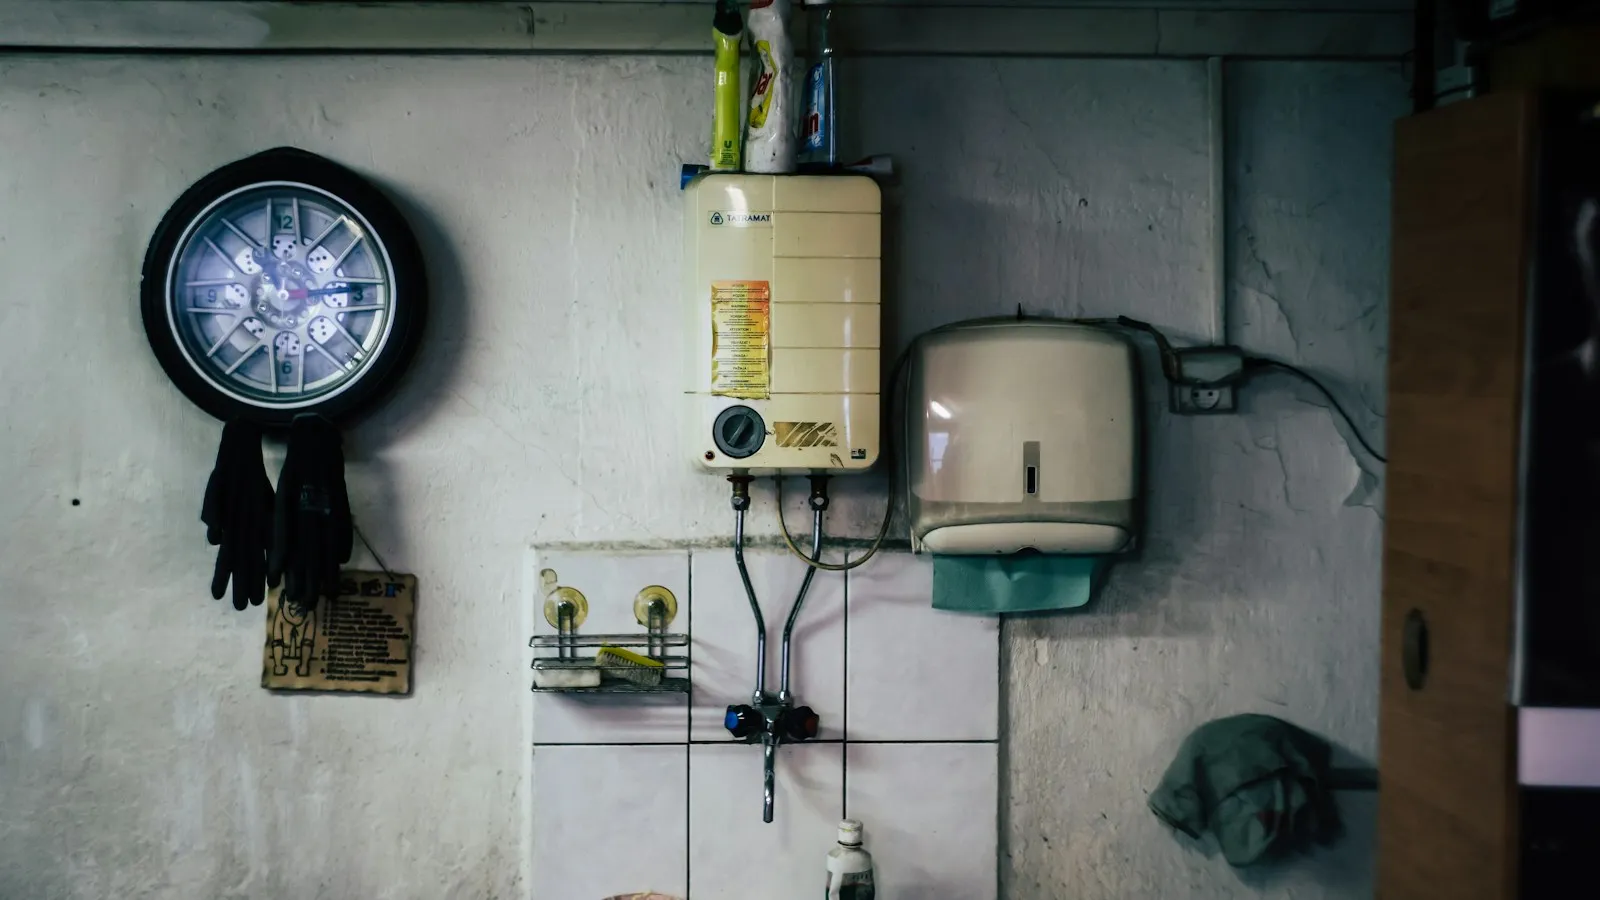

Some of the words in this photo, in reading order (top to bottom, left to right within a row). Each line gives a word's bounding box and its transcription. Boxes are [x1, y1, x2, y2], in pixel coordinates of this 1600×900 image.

[277, 215, 293, 229] 12
[727, 214, 771, 222] TATRAMAT
[208, 289, 217, 302] 9
[353, 288, 363, 301] 3
[282, 361, 292, 374] 6
